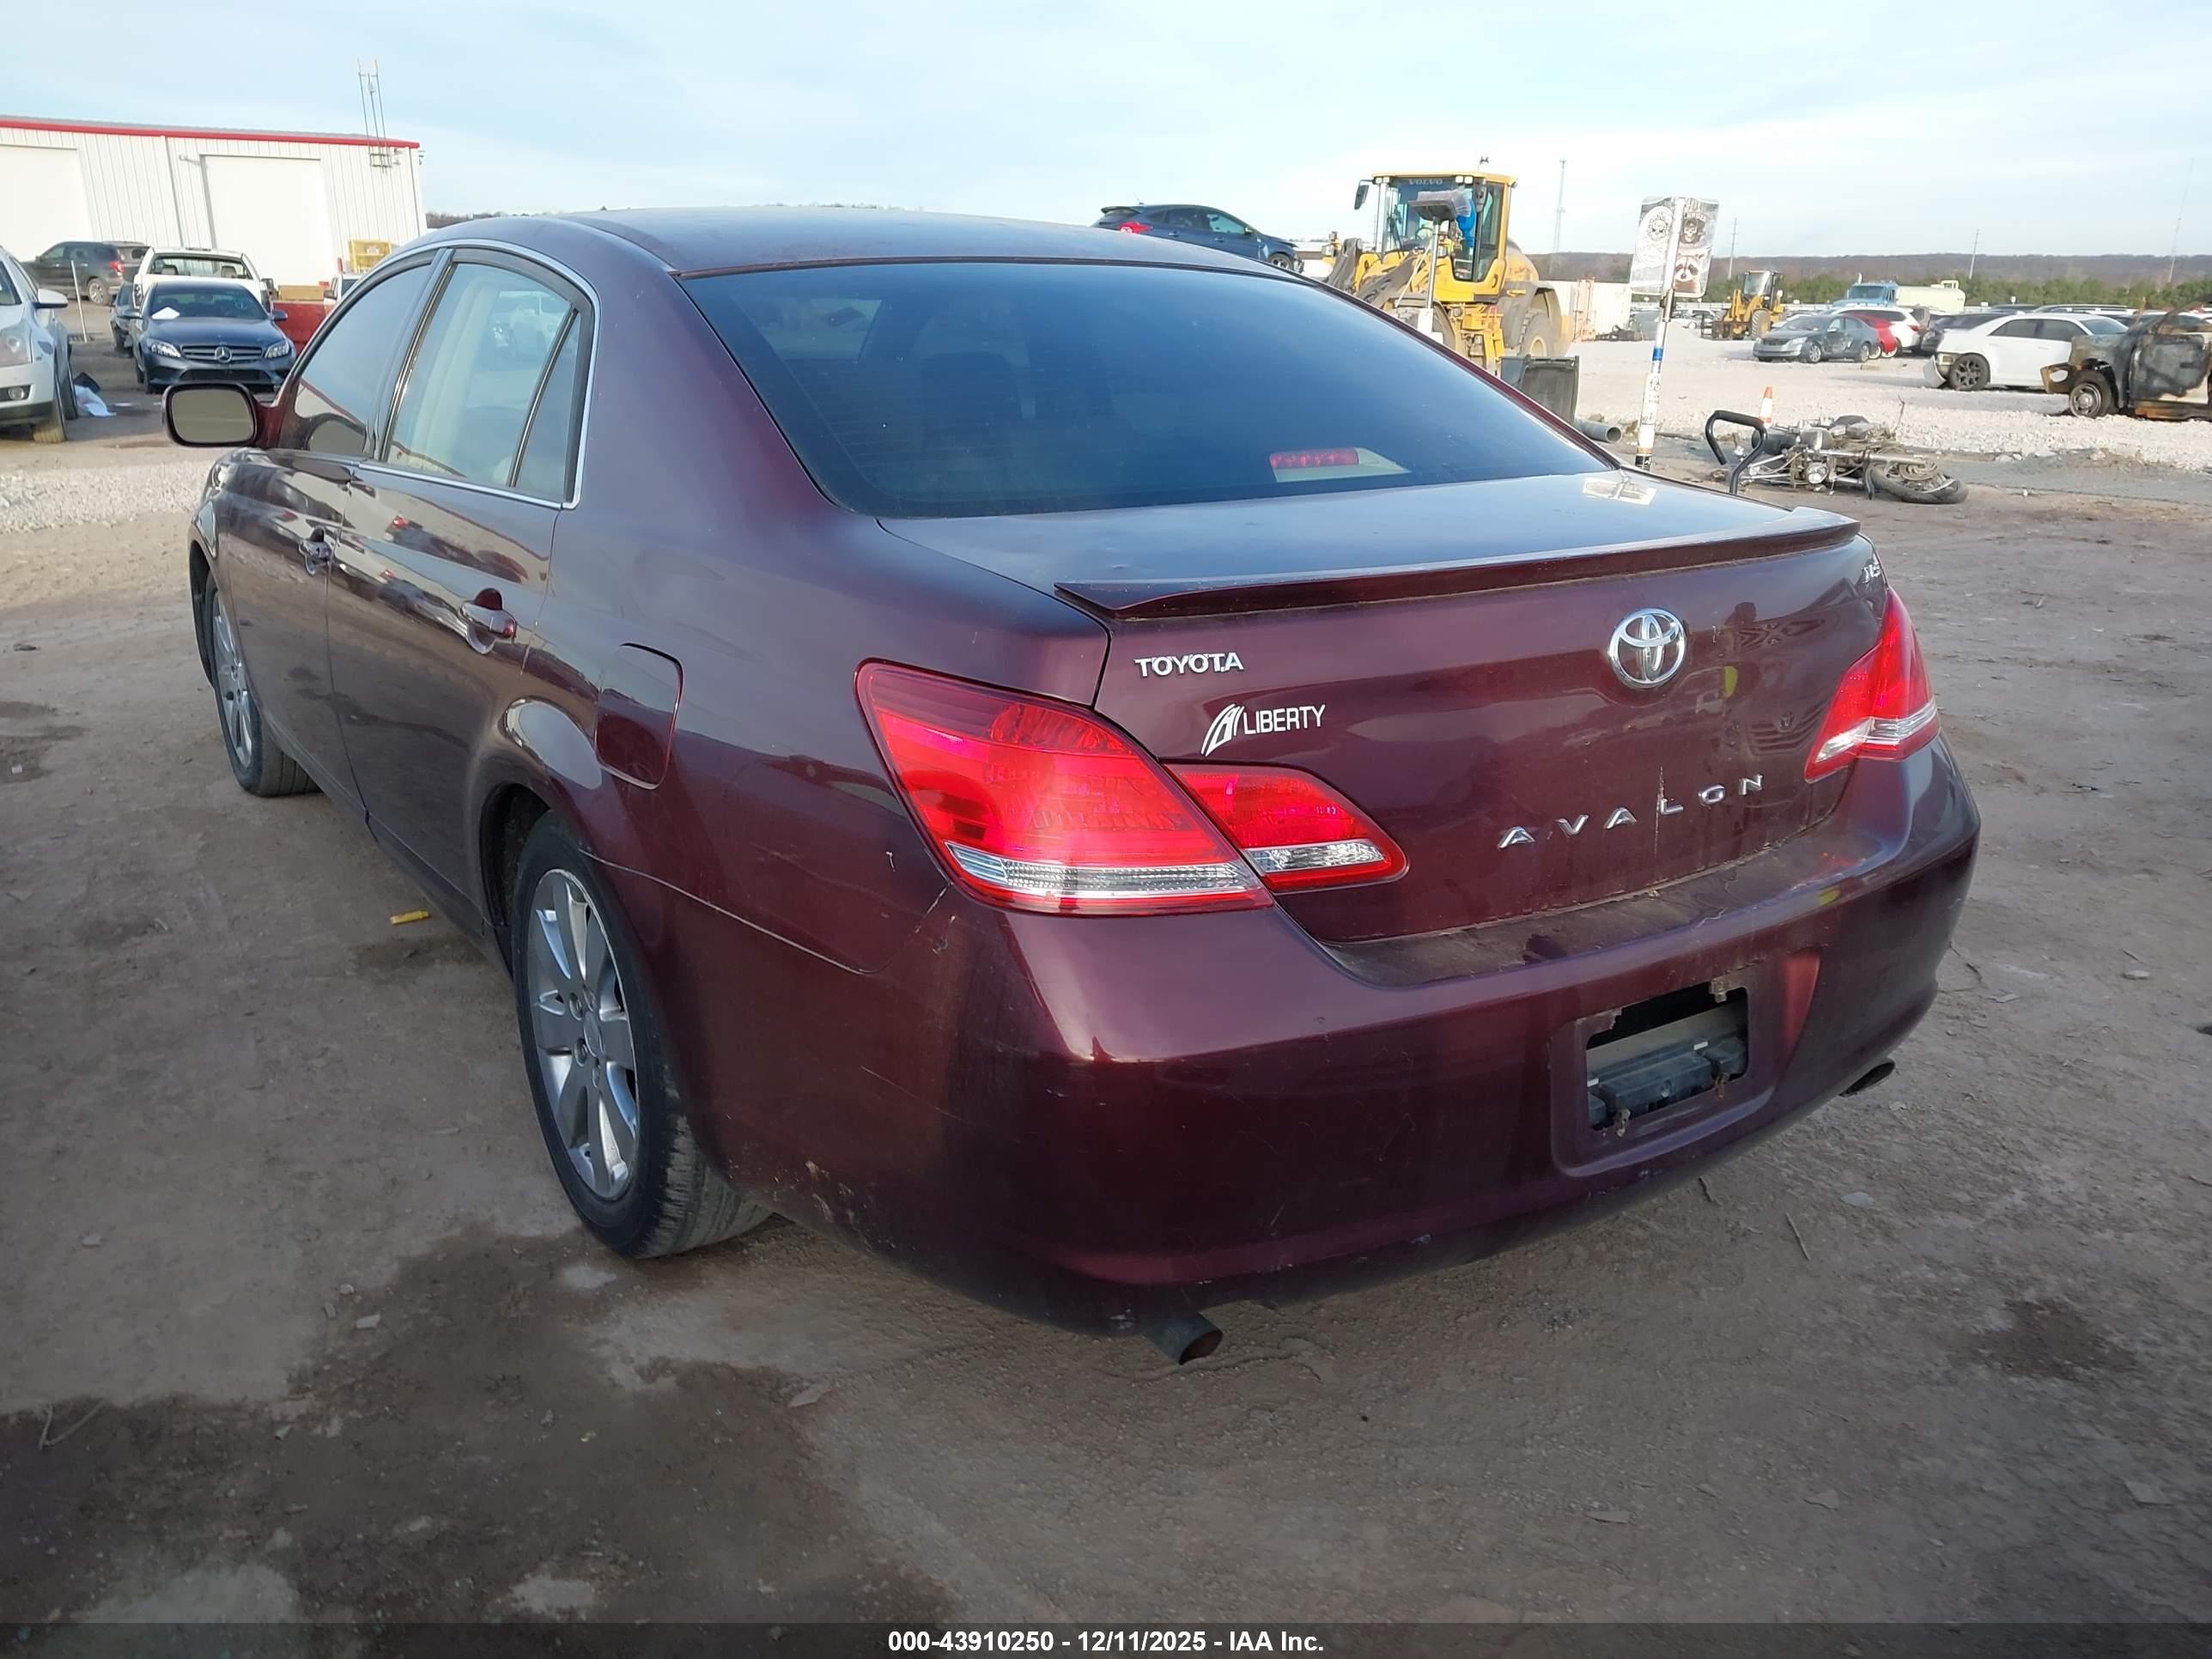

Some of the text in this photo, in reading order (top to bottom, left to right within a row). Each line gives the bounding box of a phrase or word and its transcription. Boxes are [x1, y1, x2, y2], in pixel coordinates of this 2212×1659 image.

[1134, 652, 1244, 678] TOYOTA
[1243, 704, 1326, 735] LIBERTY
[1498, 774, 1765, 848] AVALON
